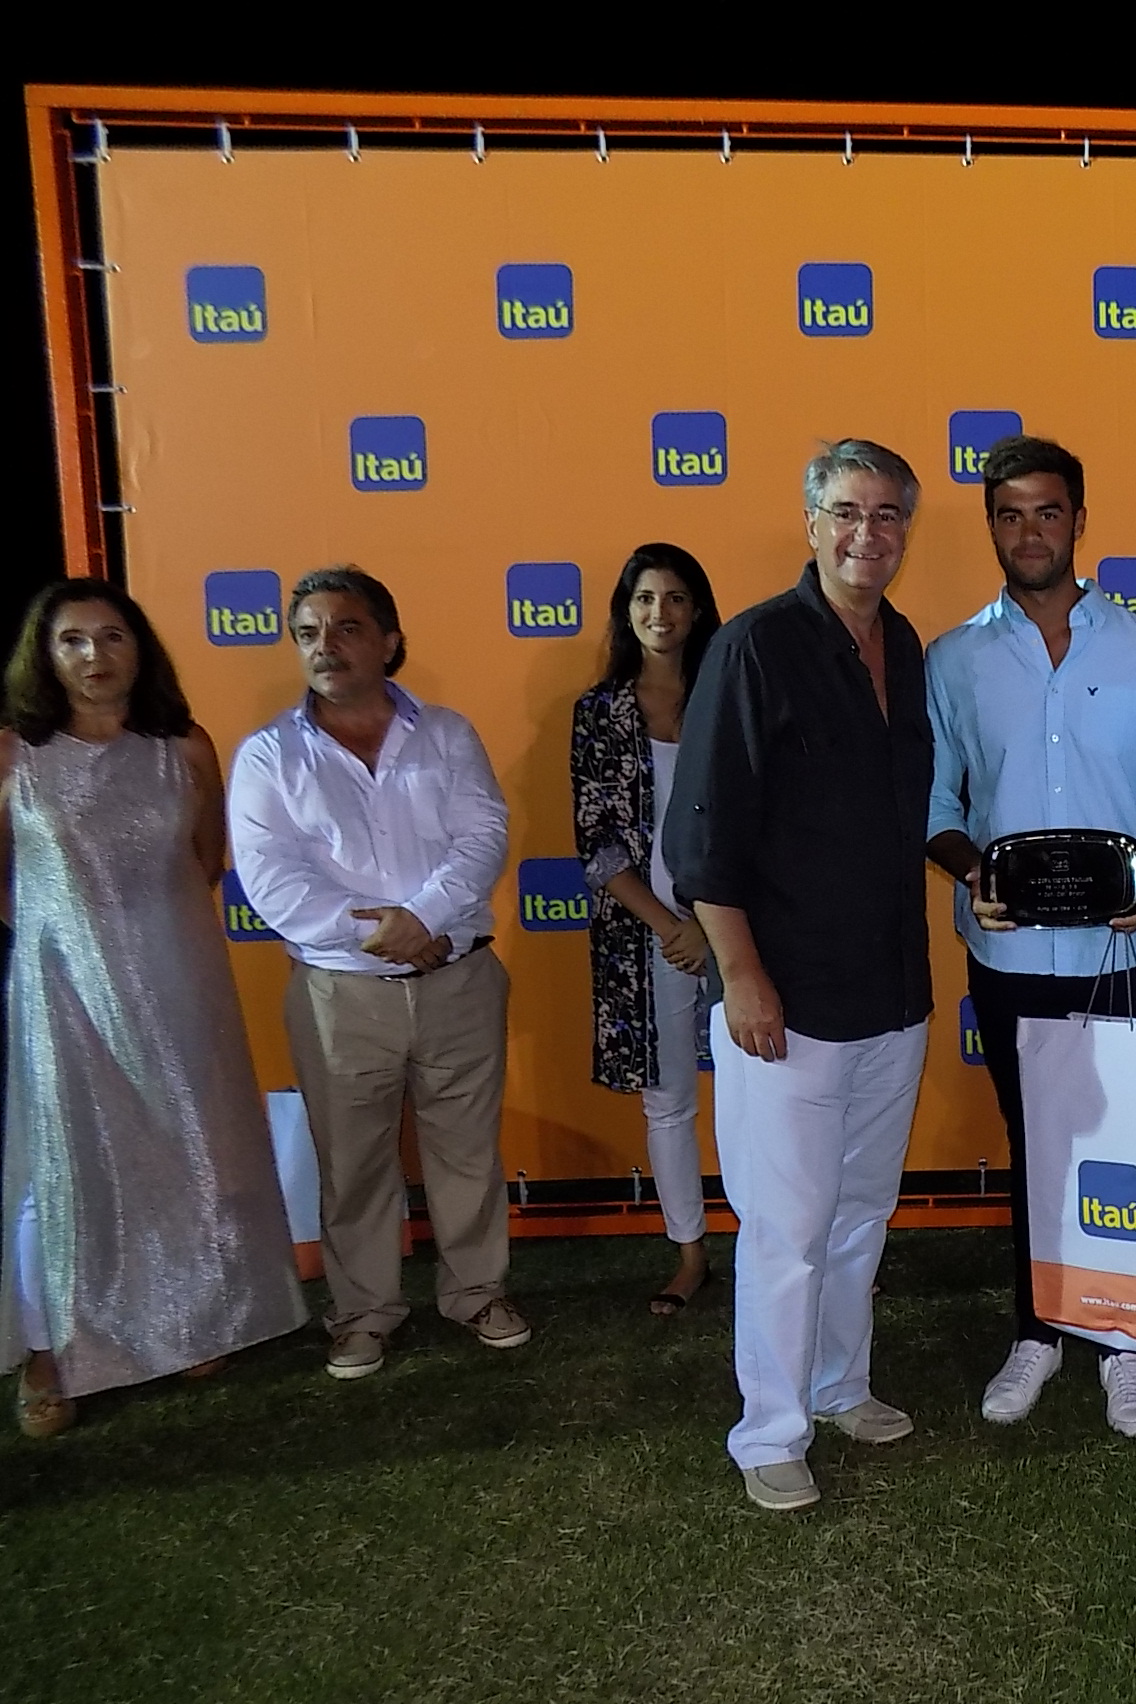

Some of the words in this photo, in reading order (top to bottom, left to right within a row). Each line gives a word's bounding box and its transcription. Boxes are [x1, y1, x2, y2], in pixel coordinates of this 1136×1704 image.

[193, 303, 264, 333] Itaú
[501, 300, 571, 330] Itaú
[803, 298, 870, 327] Itaú
[355, 452, 424, 482] Itaú
[657, 446, 724, 477] Itaú
[954, 446, 990, 474] Ita
[209, 608, 279, 637] Itaú
[512, 598, 579, 627] Itaú
[524, 893, 589, 921] Itaú
